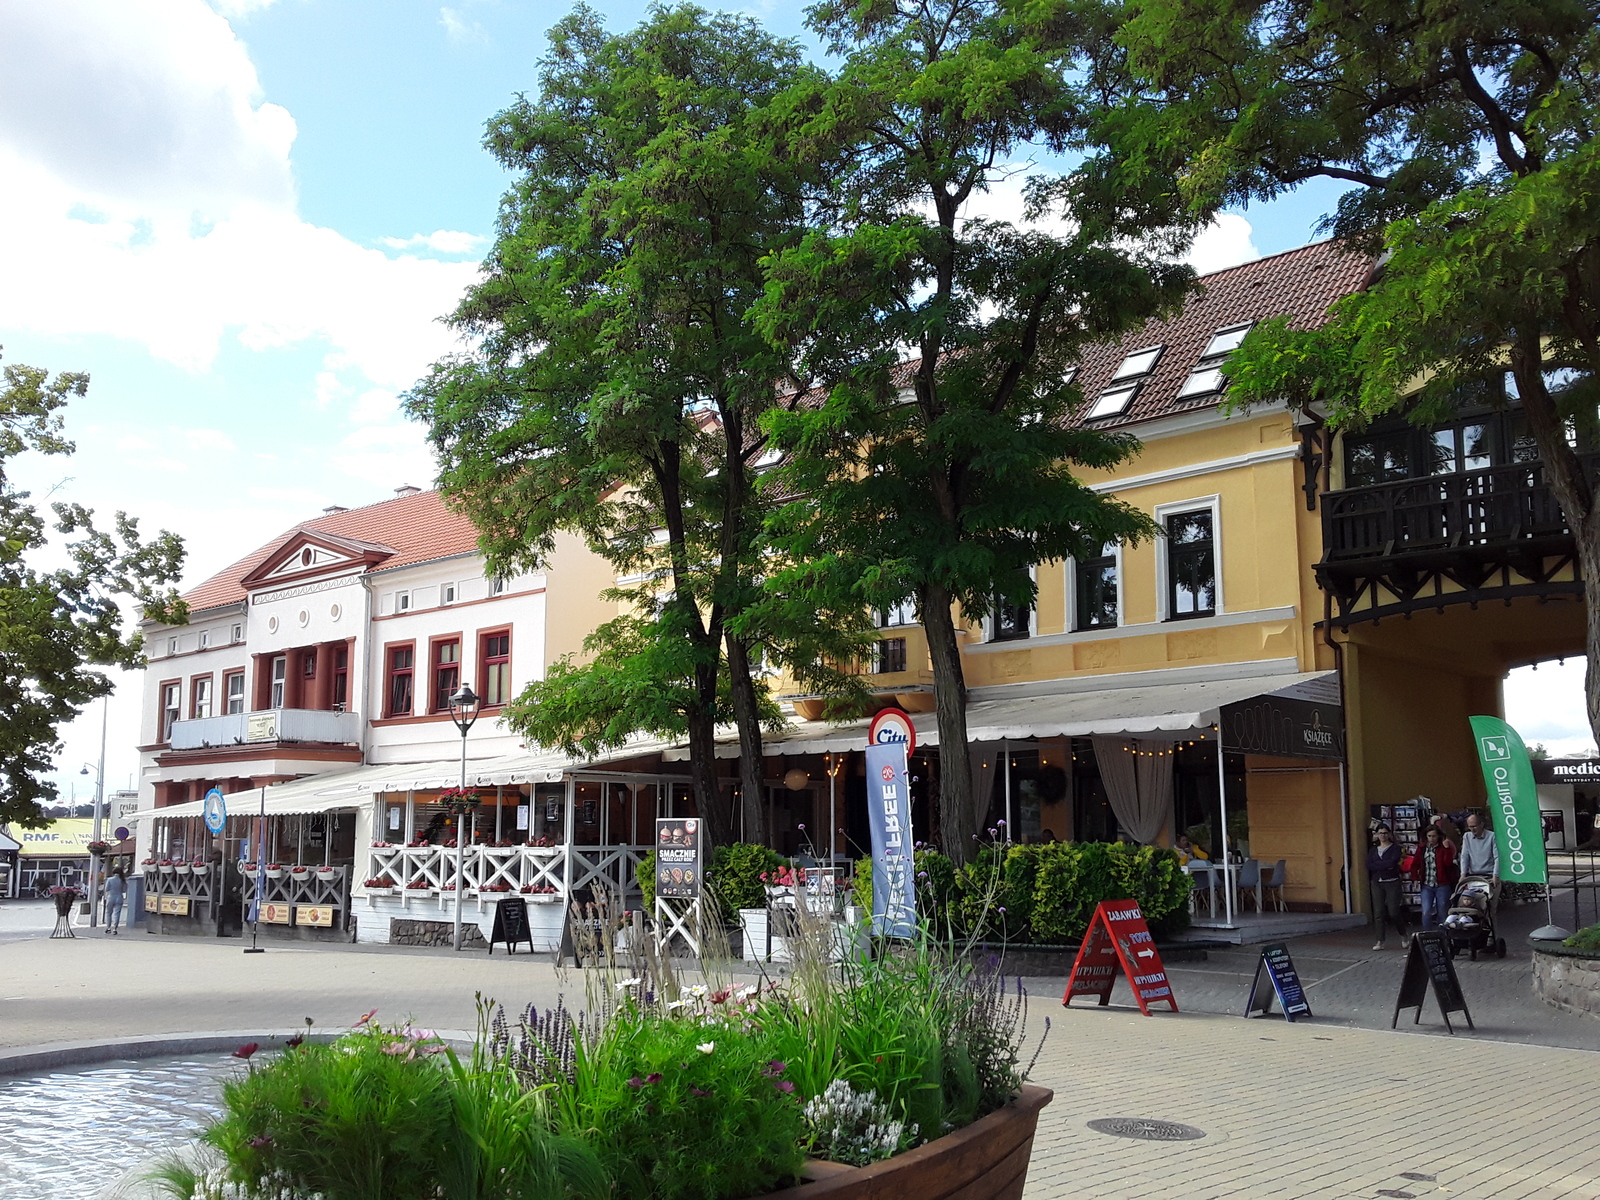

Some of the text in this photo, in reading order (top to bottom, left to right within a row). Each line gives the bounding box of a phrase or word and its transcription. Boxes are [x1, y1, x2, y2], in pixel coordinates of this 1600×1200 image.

[23, 833, 60, 842] RMF
[659, 849, 696, 858] SMACZNIE
[1107, 909, 1141, 921] ZABAWKI
[1129, 931, 1152, 944] TOYS
